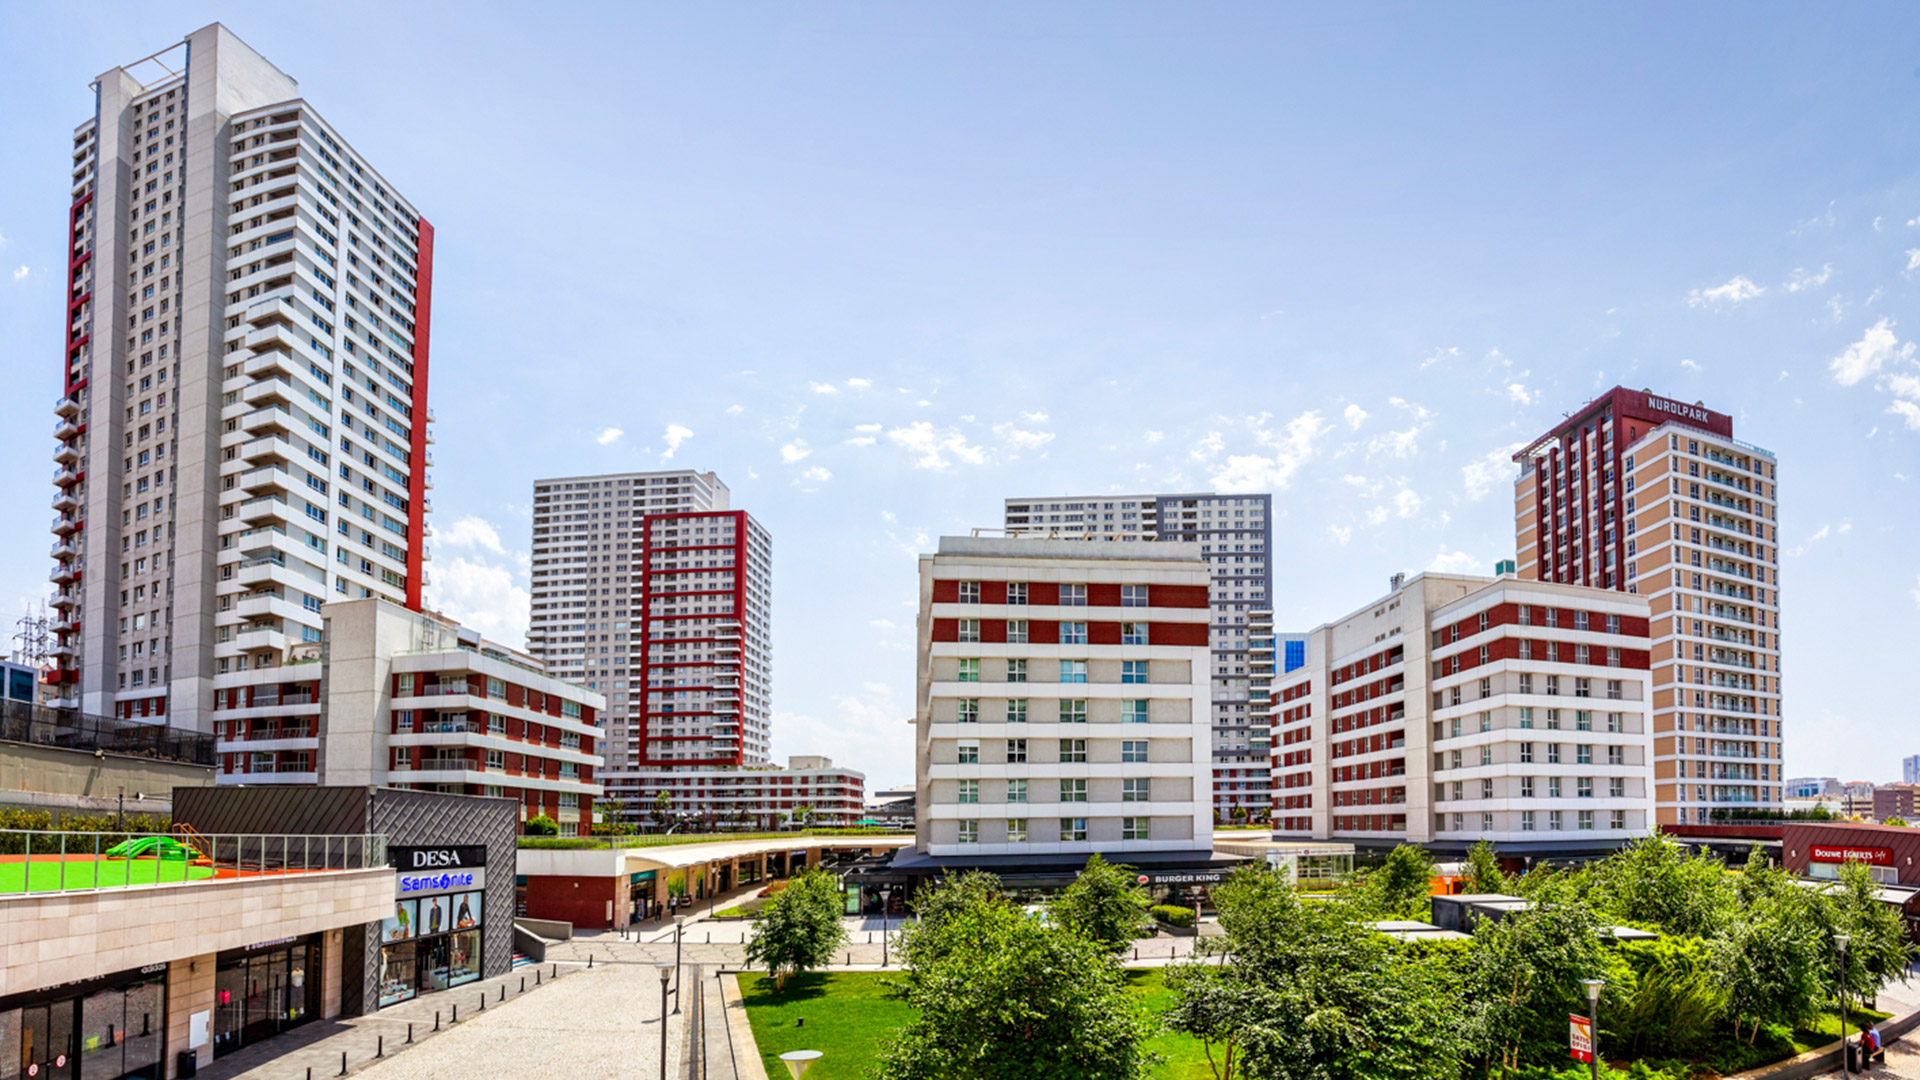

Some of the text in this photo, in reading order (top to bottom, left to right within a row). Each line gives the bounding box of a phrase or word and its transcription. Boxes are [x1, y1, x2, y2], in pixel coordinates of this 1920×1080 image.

[1648, 397, 1709, 423] NUROLPARK
[413, 850, 461, 867] DESA
[401, 873, 473, 892] Samsonite
